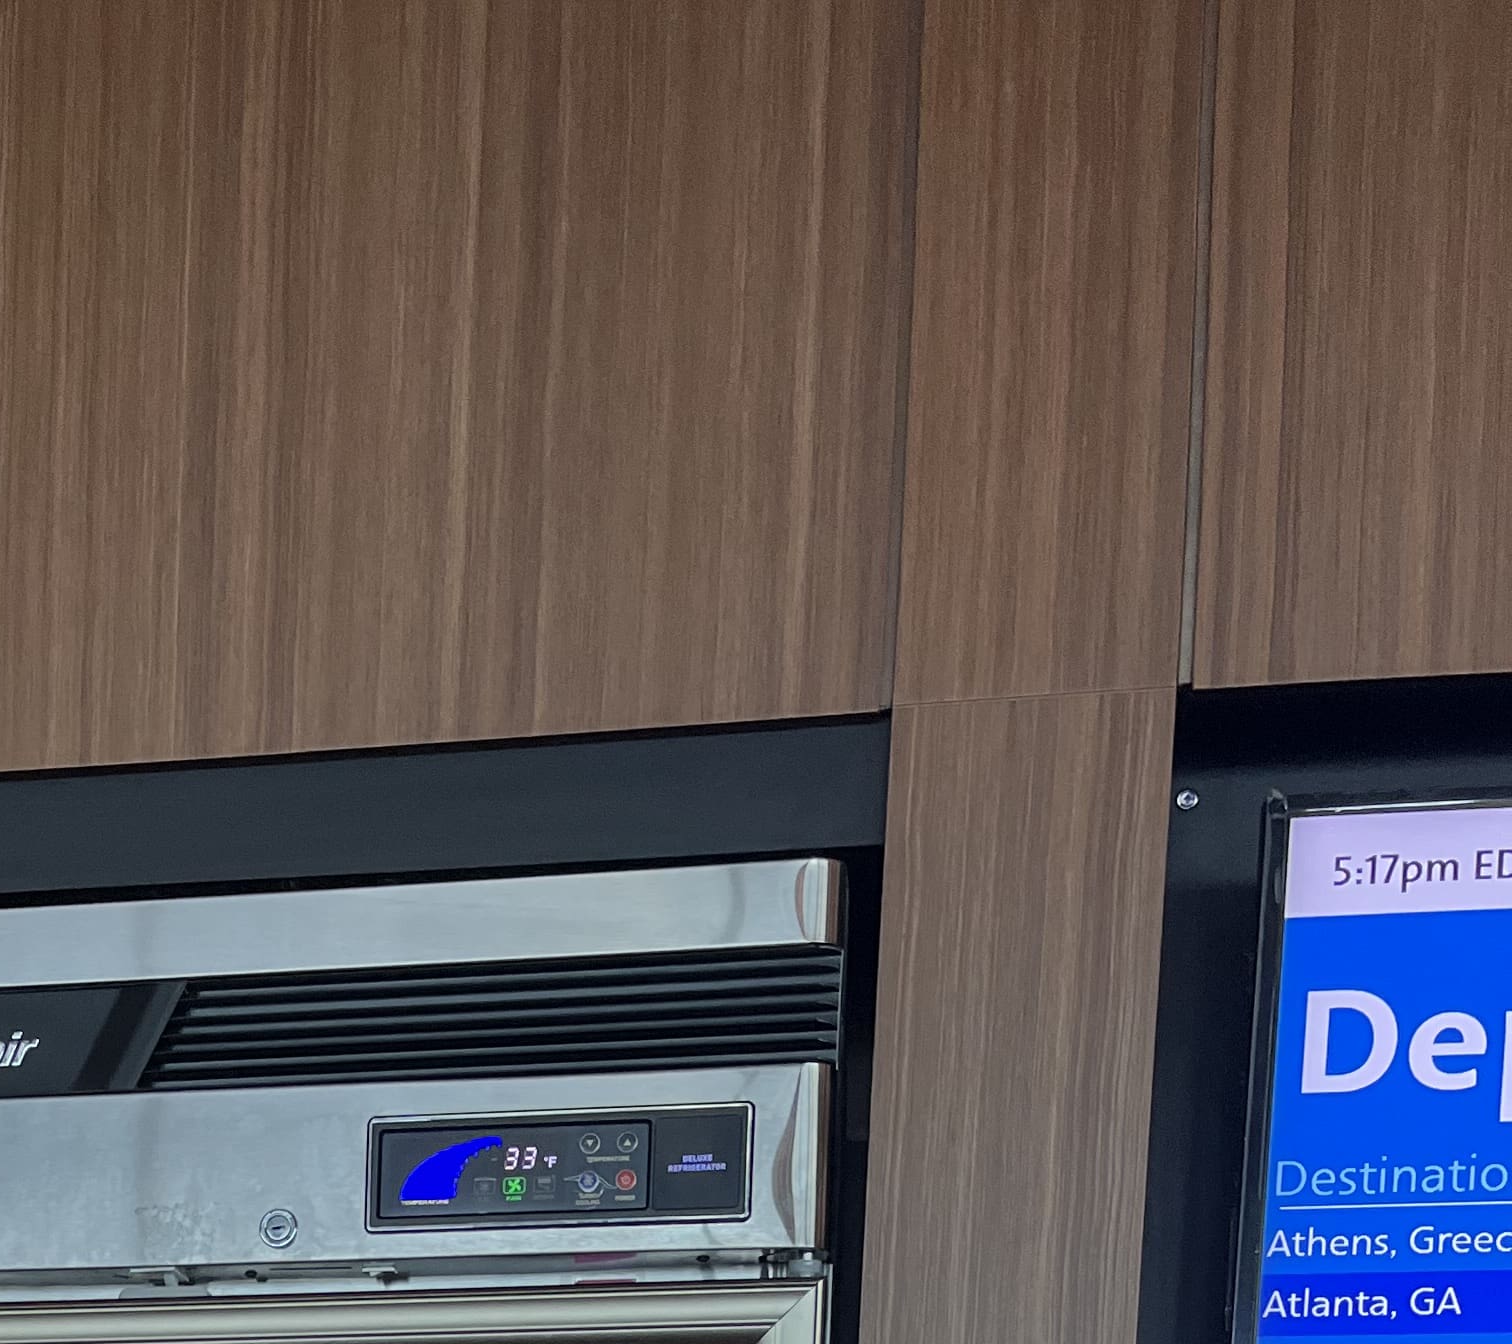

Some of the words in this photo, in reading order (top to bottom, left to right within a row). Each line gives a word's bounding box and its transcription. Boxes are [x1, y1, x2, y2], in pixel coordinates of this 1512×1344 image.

[1333, 854, 1459, 892] 5:17pm
[504, 1147, 537, 1170] 33
[1267, 1229, 1397, 1258] Athens,
[1263, 1288, 1397, 1320] Atlanta,
[1410, 1287, 1461, 1316] GA
